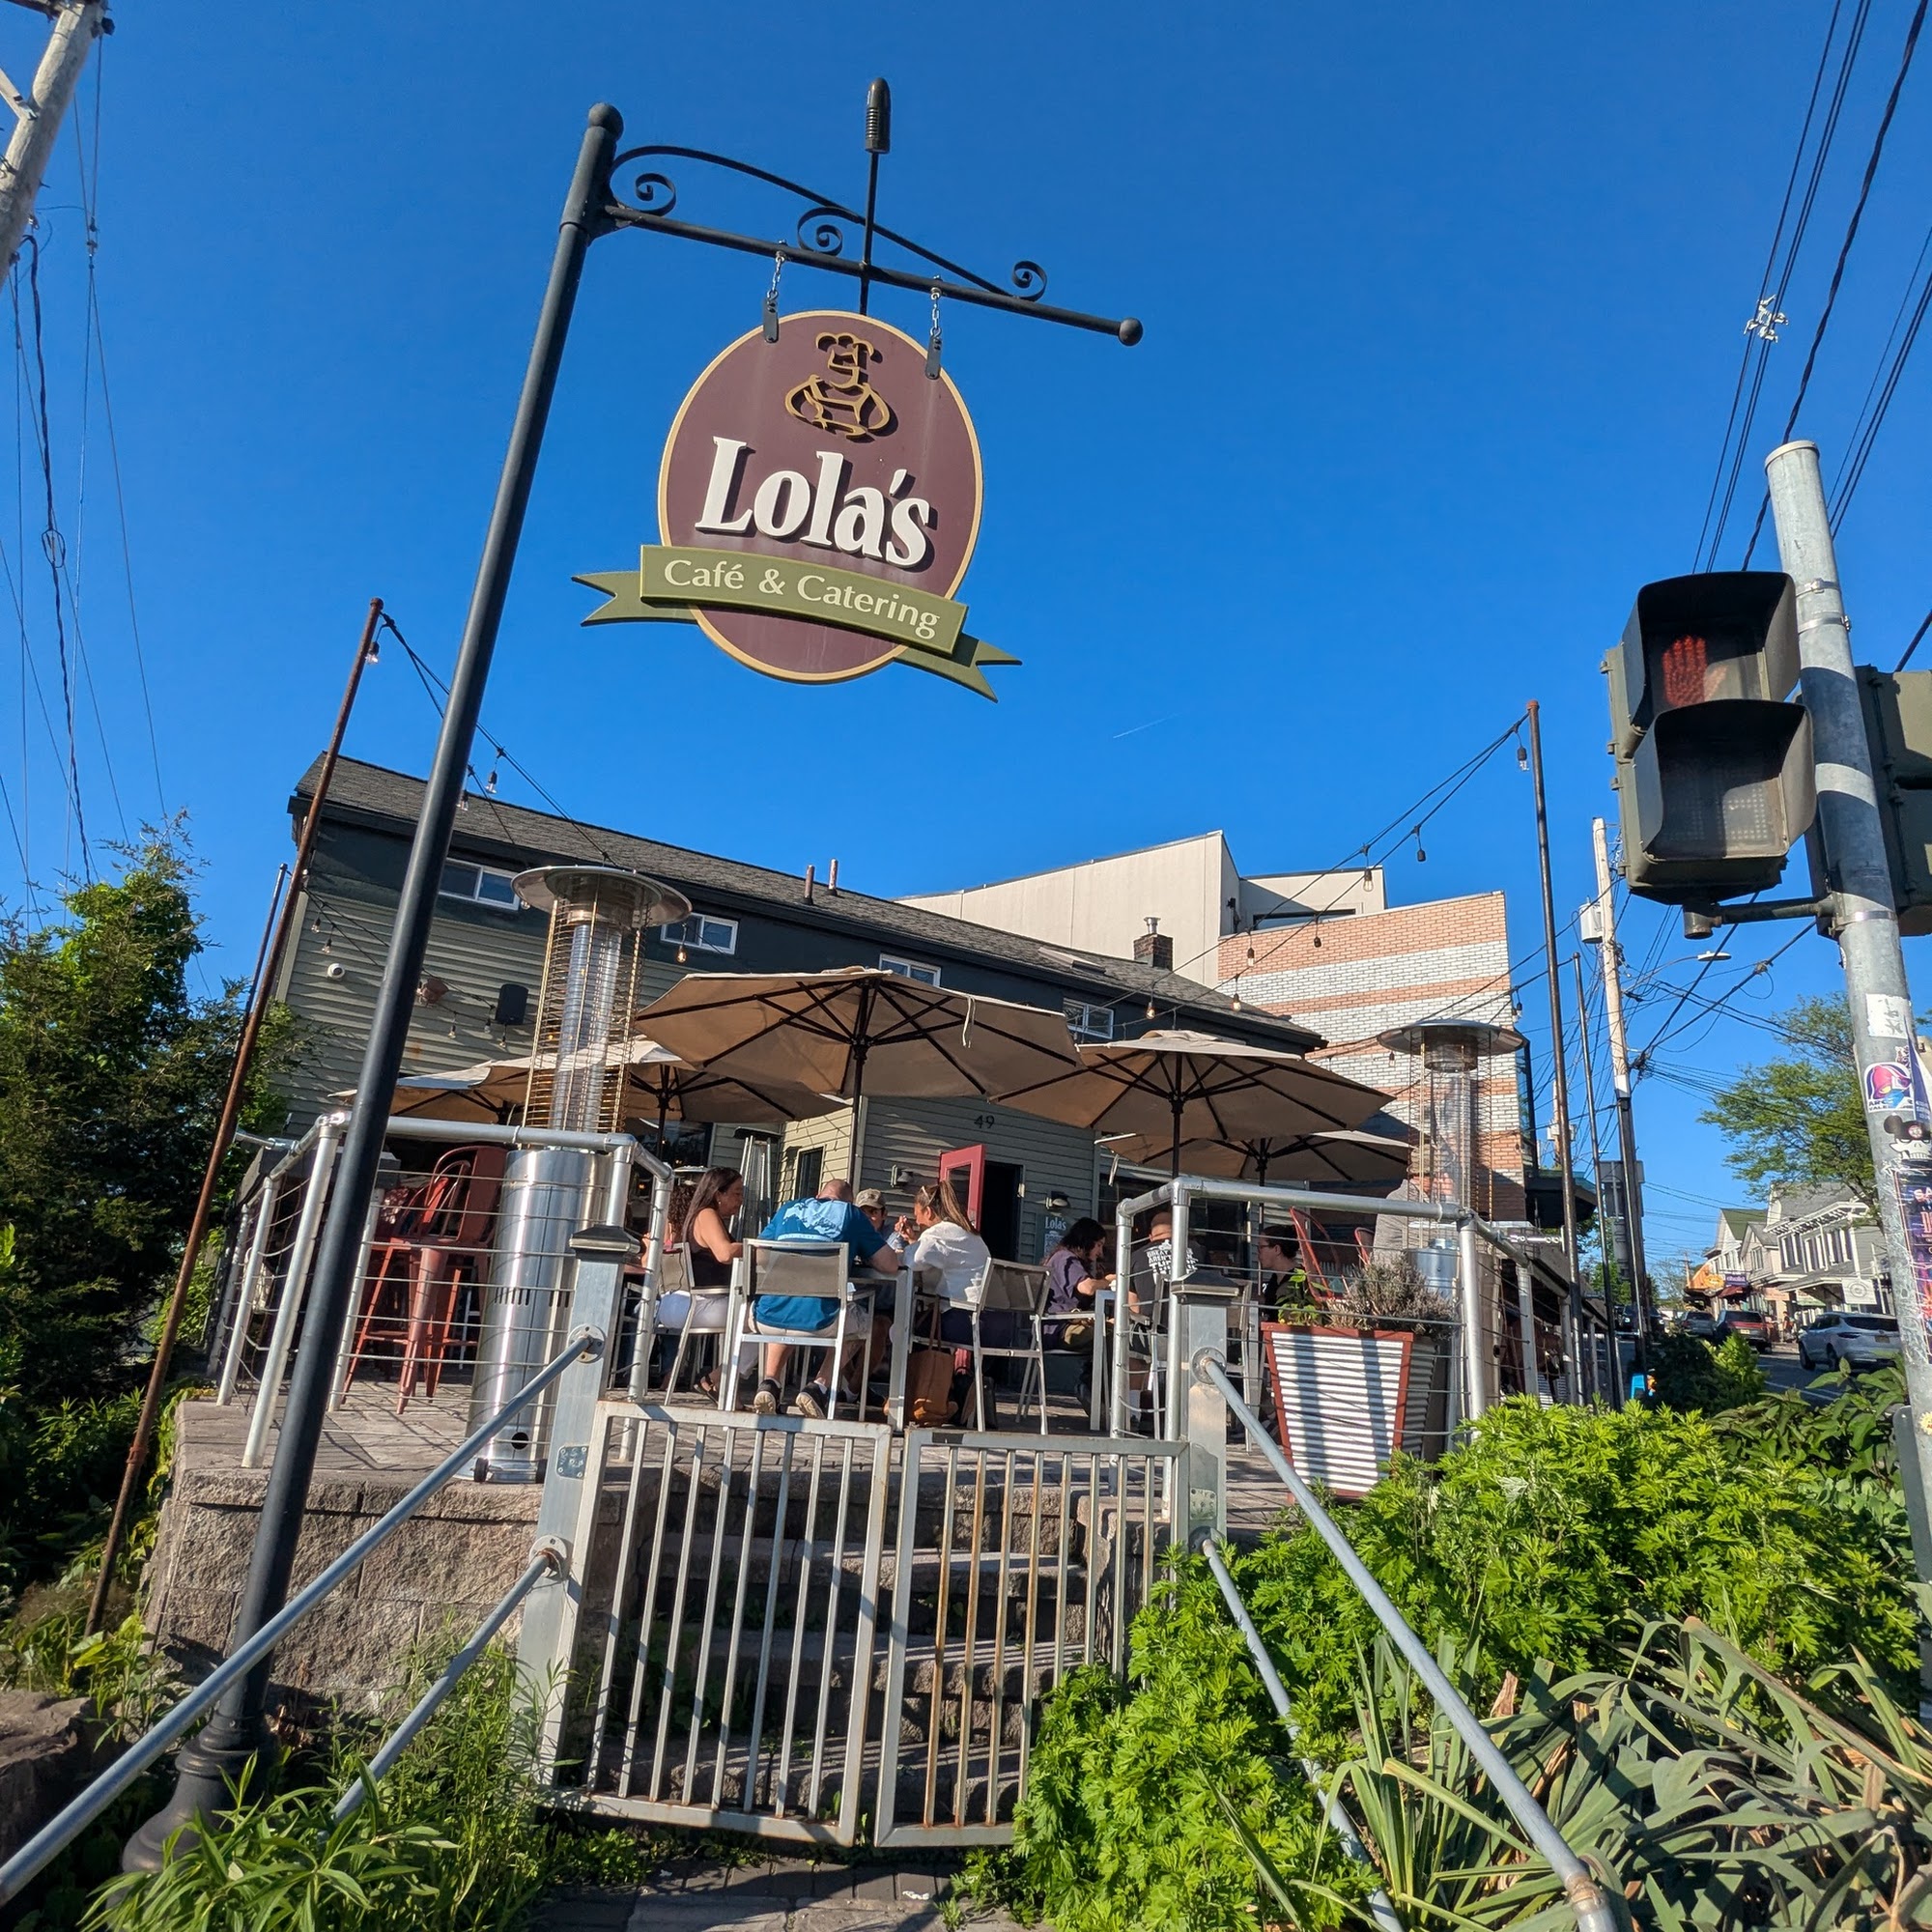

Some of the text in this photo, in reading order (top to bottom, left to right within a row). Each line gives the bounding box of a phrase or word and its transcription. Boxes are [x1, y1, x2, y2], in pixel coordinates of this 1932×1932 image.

[695, 436, 931, 568] Lola's
[664, 558, 941, 639] Café & Catering
[974, 1114, 995, 1128] 49
[1044, 1216, 1066, 1231] Lola's
